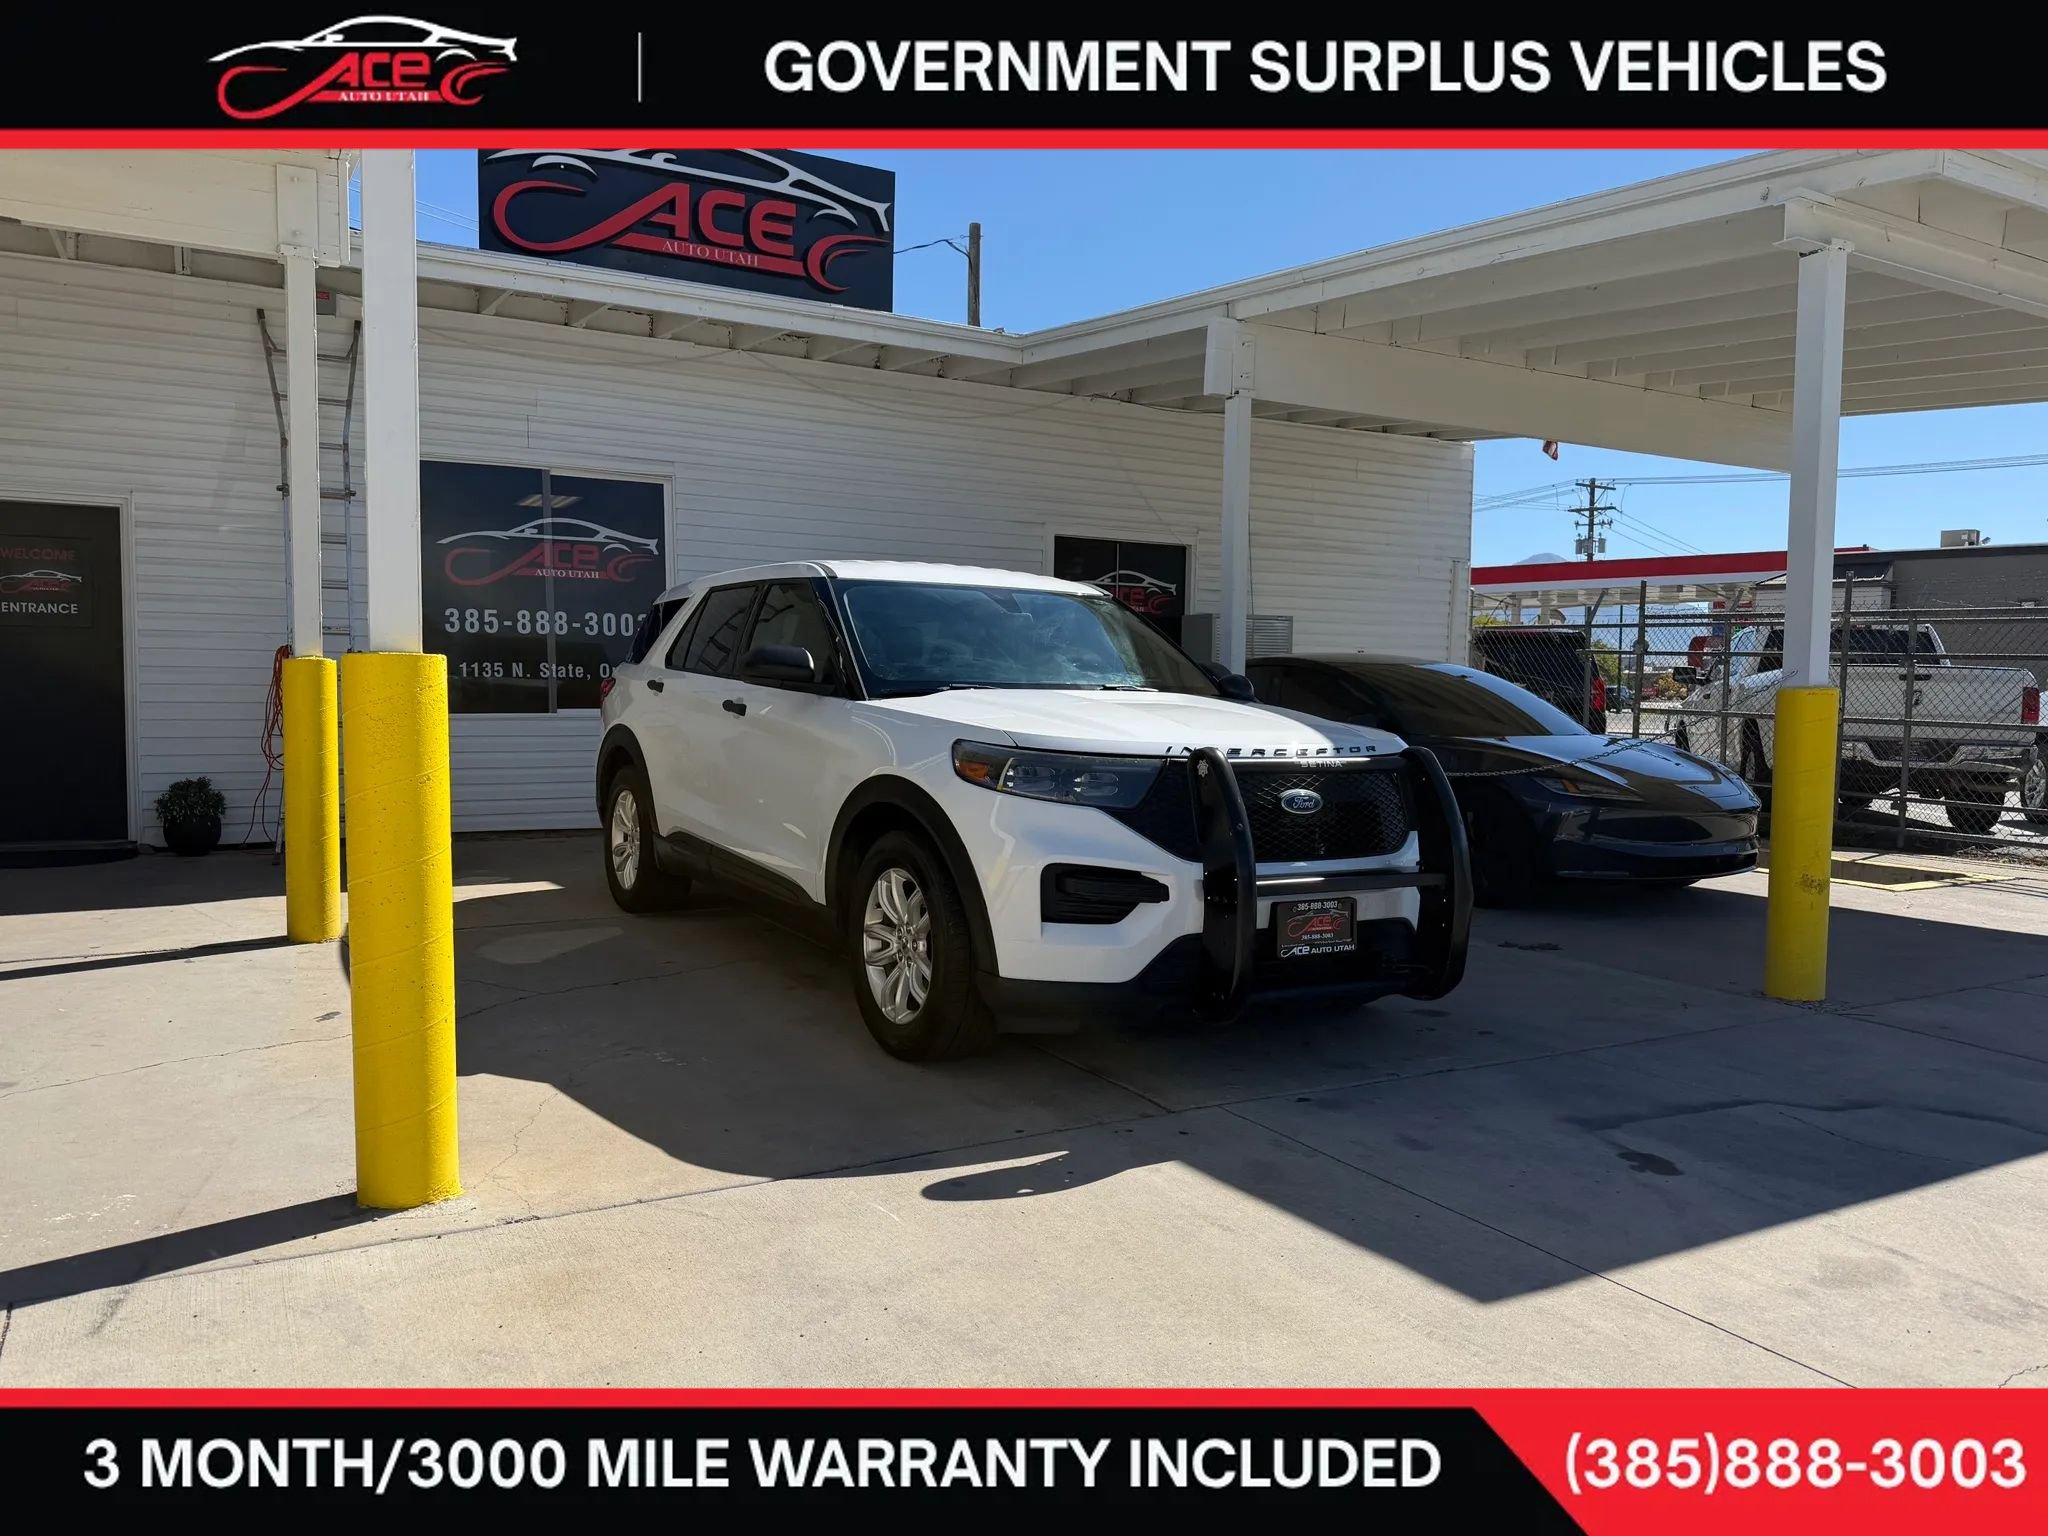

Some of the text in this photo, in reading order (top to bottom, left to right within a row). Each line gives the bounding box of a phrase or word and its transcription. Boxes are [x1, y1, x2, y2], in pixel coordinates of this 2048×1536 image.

[662, 240, 759, 267] AUTO UTAH
[0, 547, 76, 561] WELCOME
[535, 568, 600, 579] AUTO UTAH
[1, 601, 80, 614] ENTRANCE
[459, 662, 504, 678] 1135
[512, 664, 531, 678] N.
[539, 664, 591, 681] State,
[1165, 745, 1378, 757] INERCEPTOR
[1292, 796, 1316, 809] Ford
[1310, 946, 1332, 954] AUTO
[1334, 944, 1355, 952] UTAH
